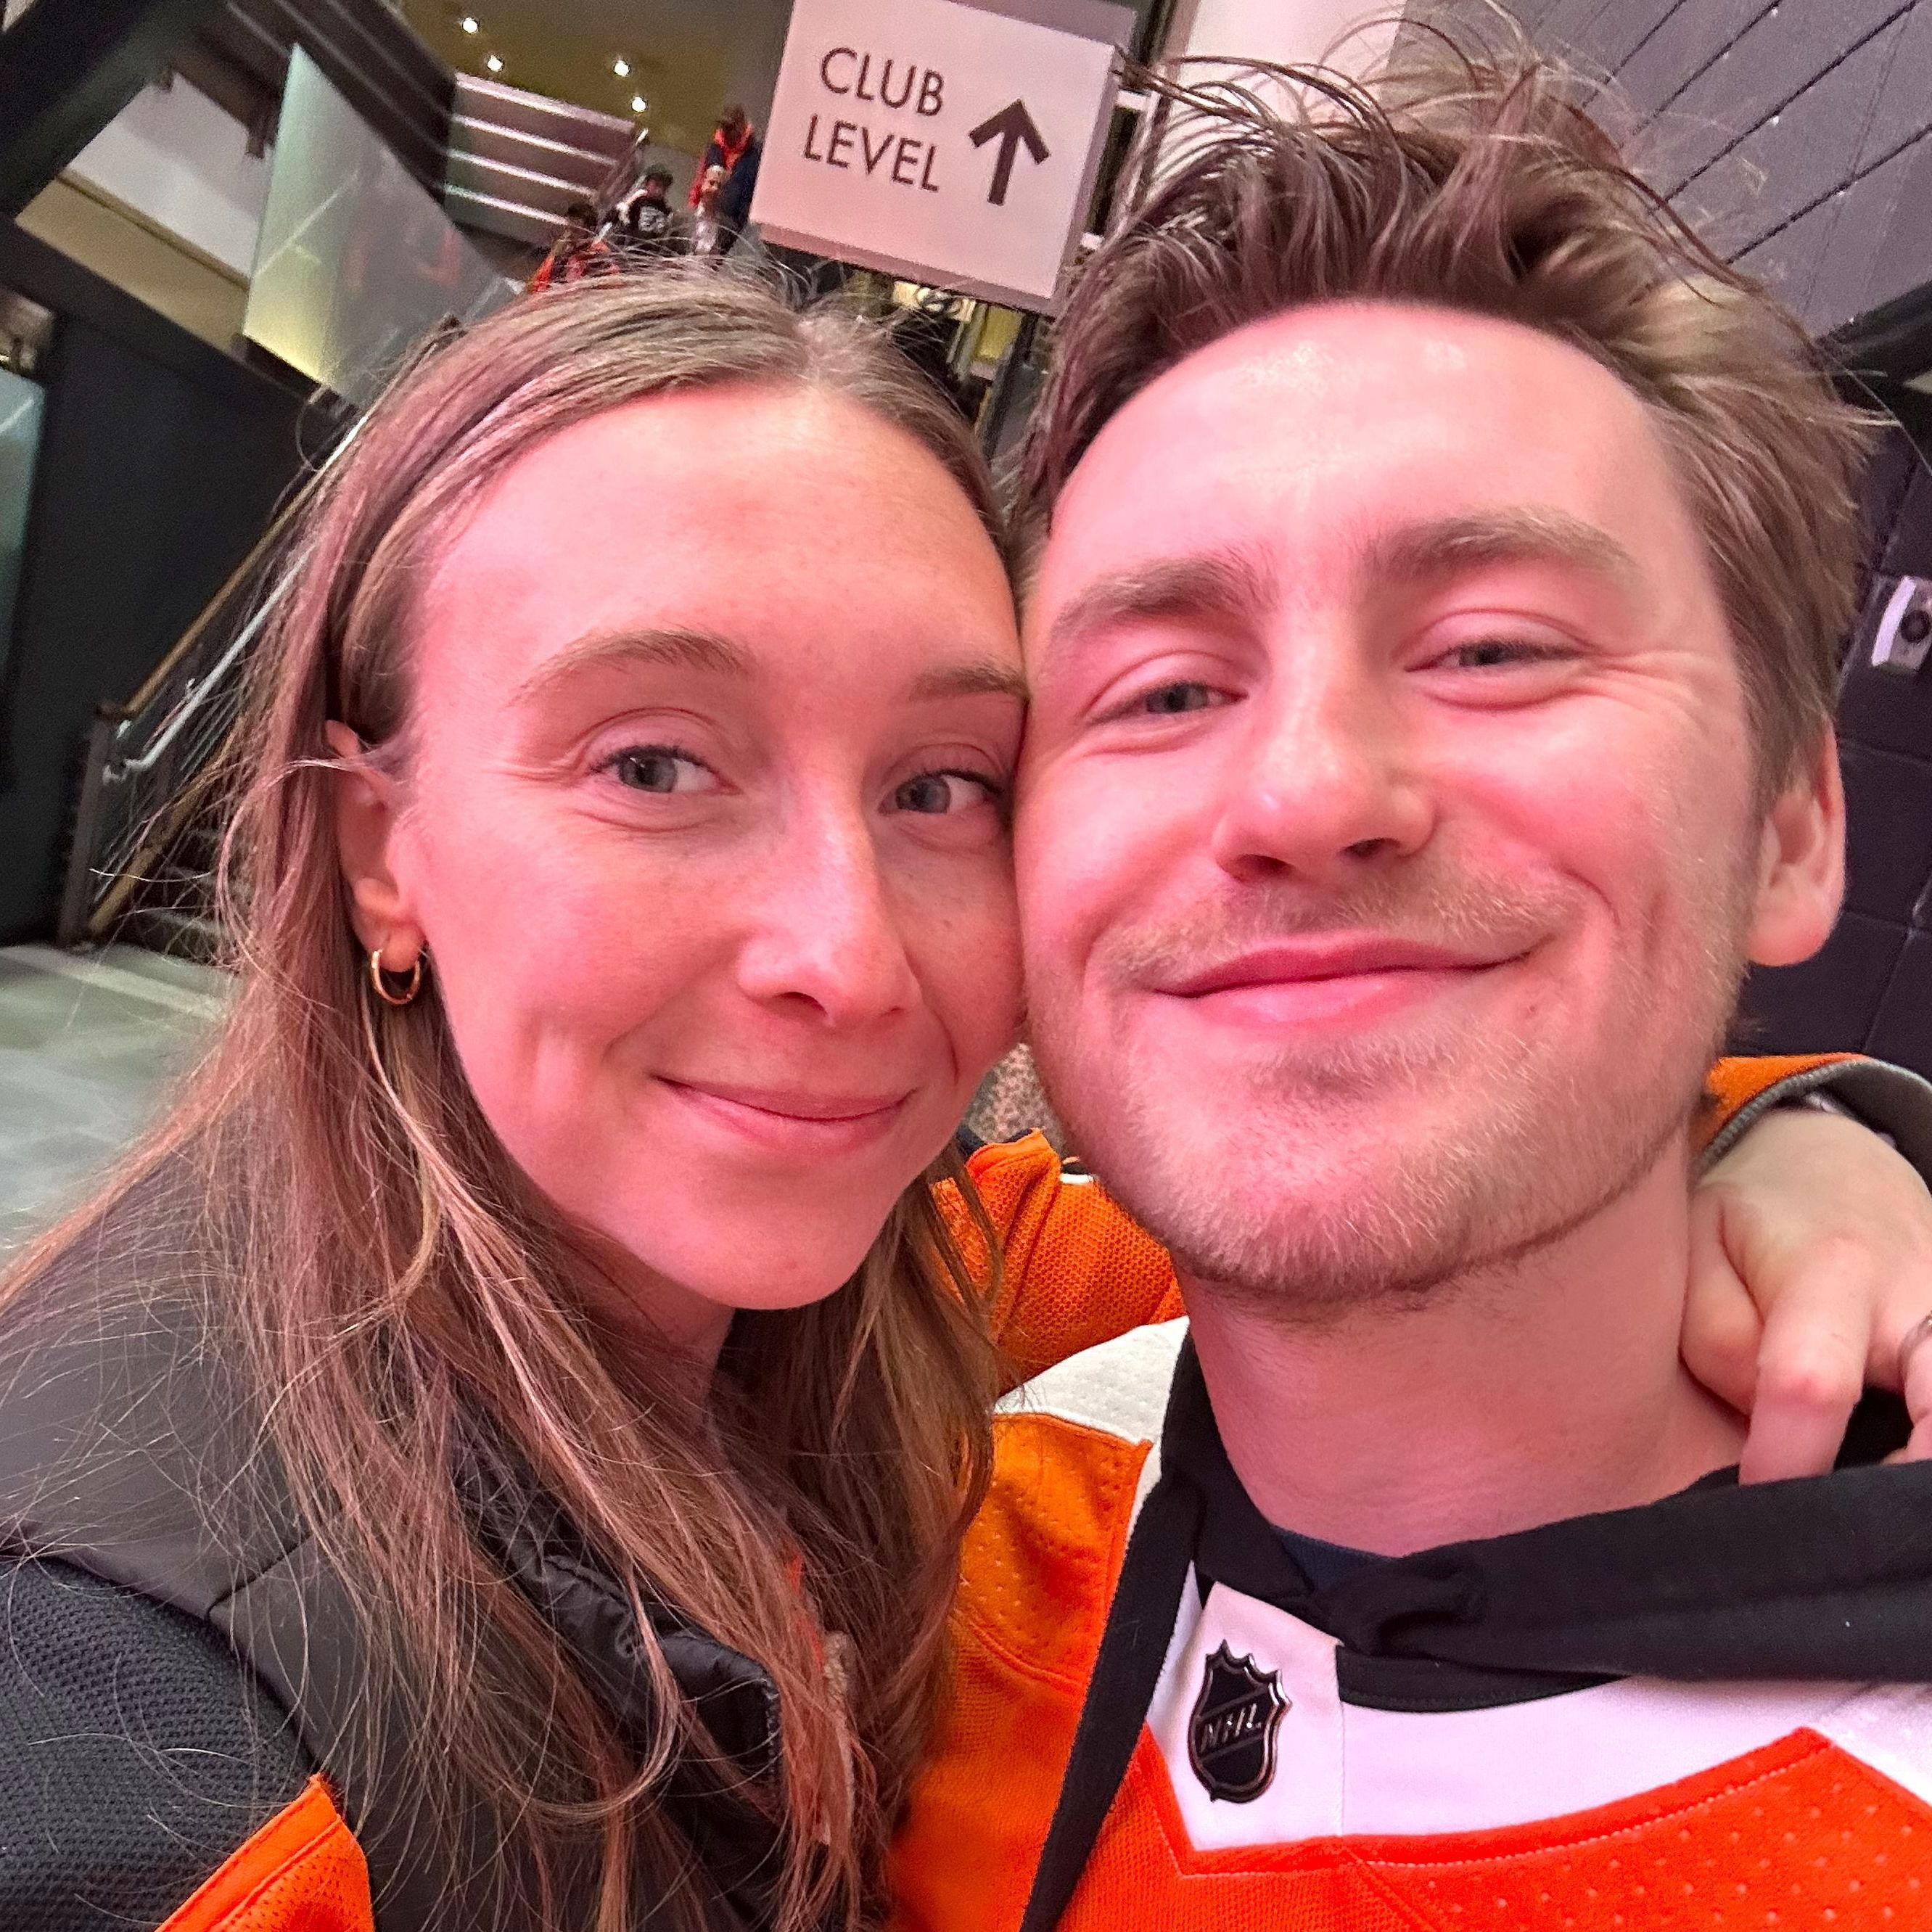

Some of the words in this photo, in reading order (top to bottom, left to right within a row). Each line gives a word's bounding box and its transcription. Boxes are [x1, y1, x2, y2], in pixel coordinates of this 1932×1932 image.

[821, 47, 944, 117] CLUB
[803, 113, 940, 192] LEVEL
[1199, 1703, 1262, 1754] NHL
